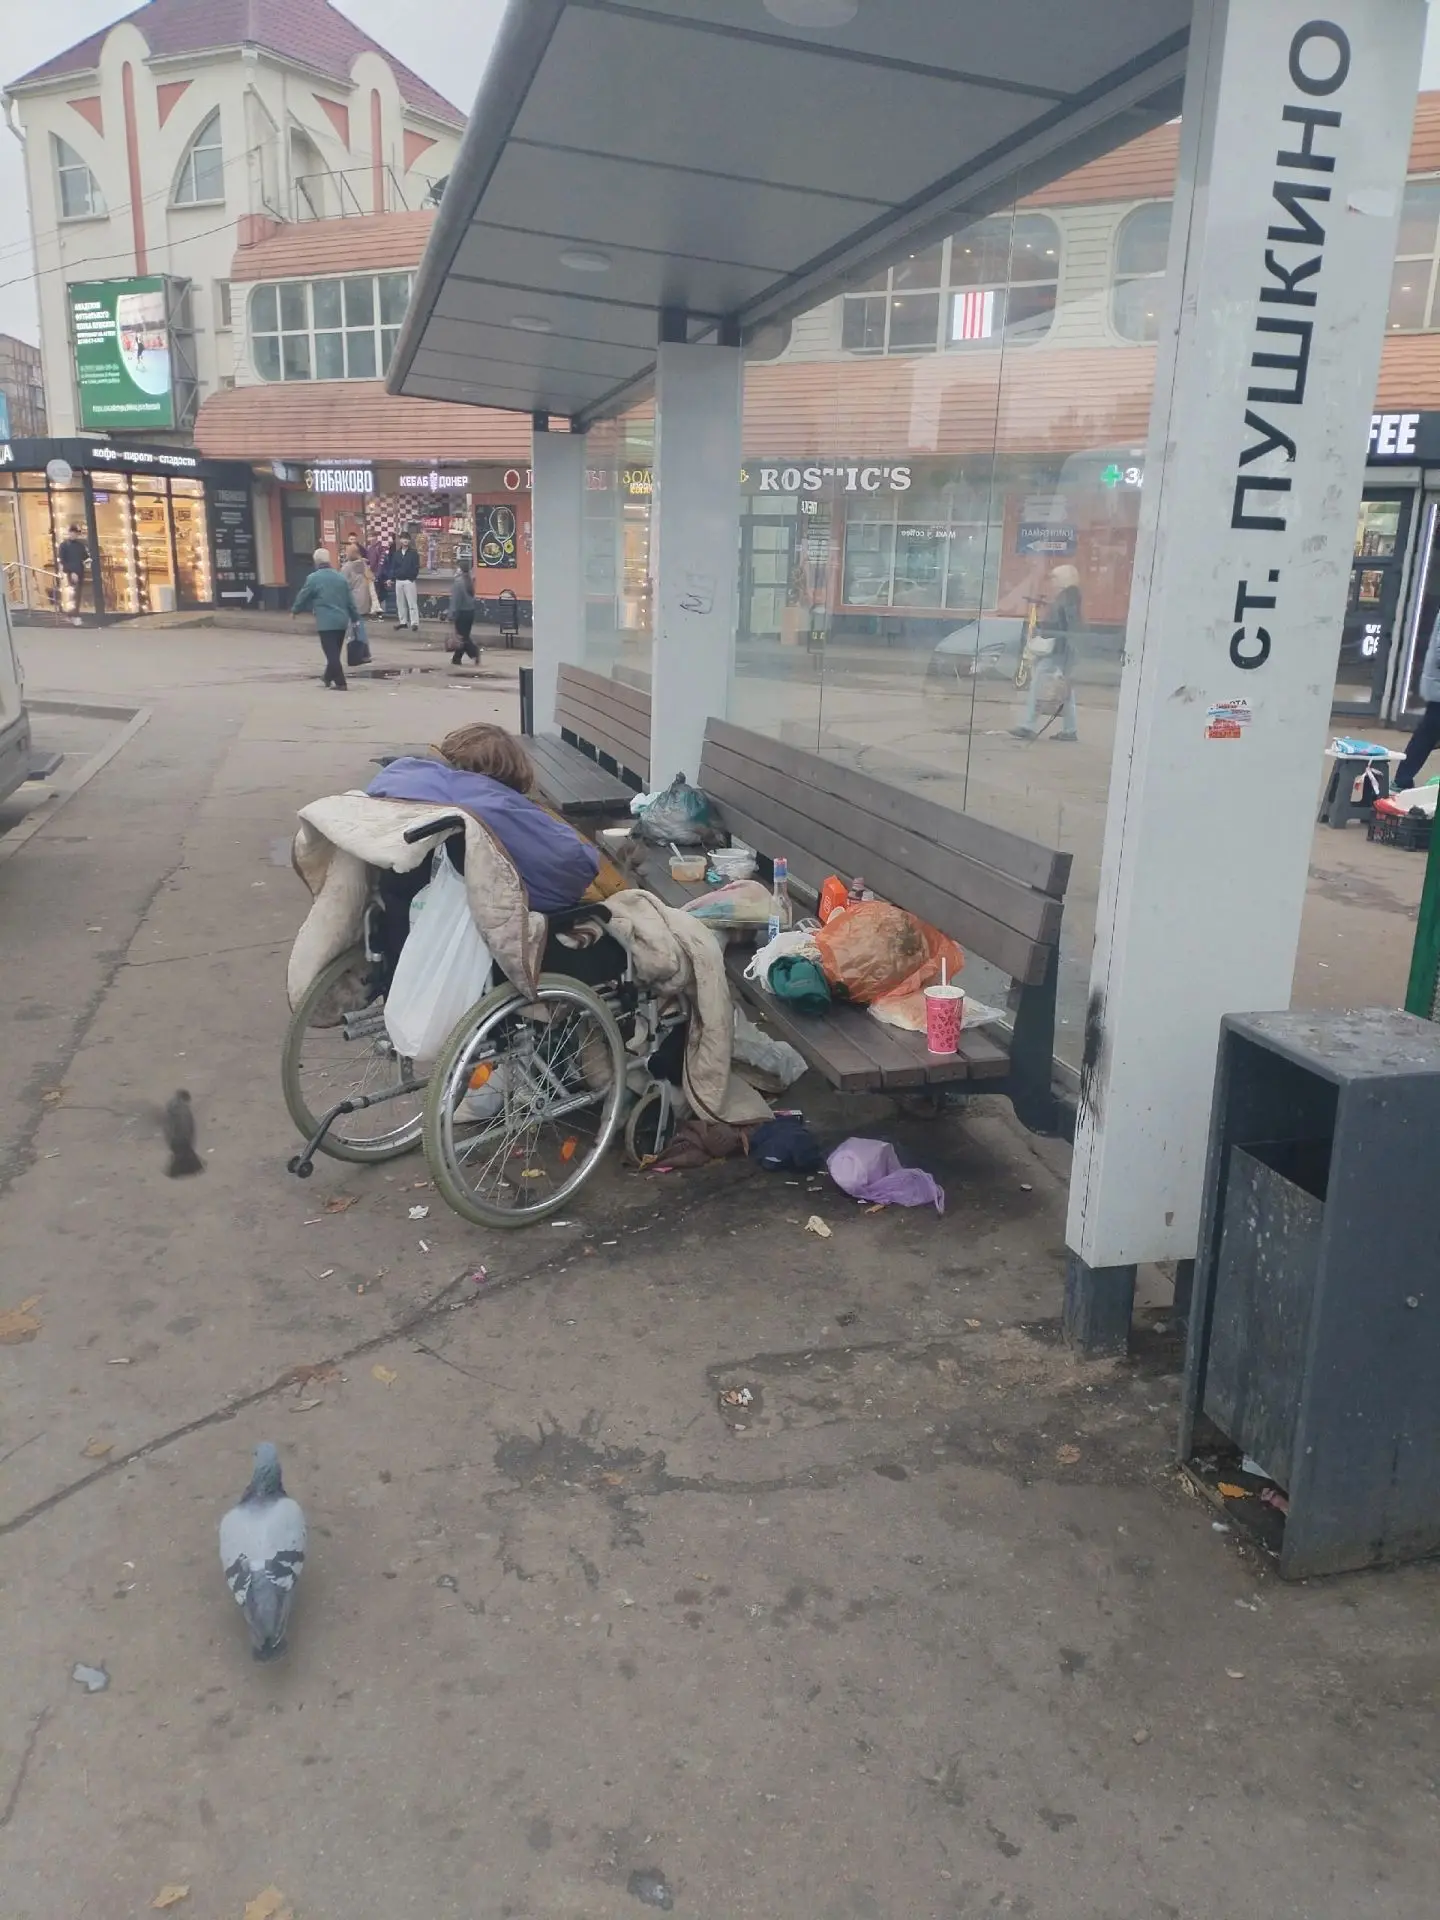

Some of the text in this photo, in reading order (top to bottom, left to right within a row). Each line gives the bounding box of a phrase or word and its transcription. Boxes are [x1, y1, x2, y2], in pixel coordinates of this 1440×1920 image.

[1231, 19, 1351, 532] ПУШКИНО
[92, 448, 117, 461] кофе
[158, 454, 197, 468] сладости
[313, 469, 374, 493] ТАБАКОВО
[400, 475, 468, 488] КЕБАБ ДОНЕР
